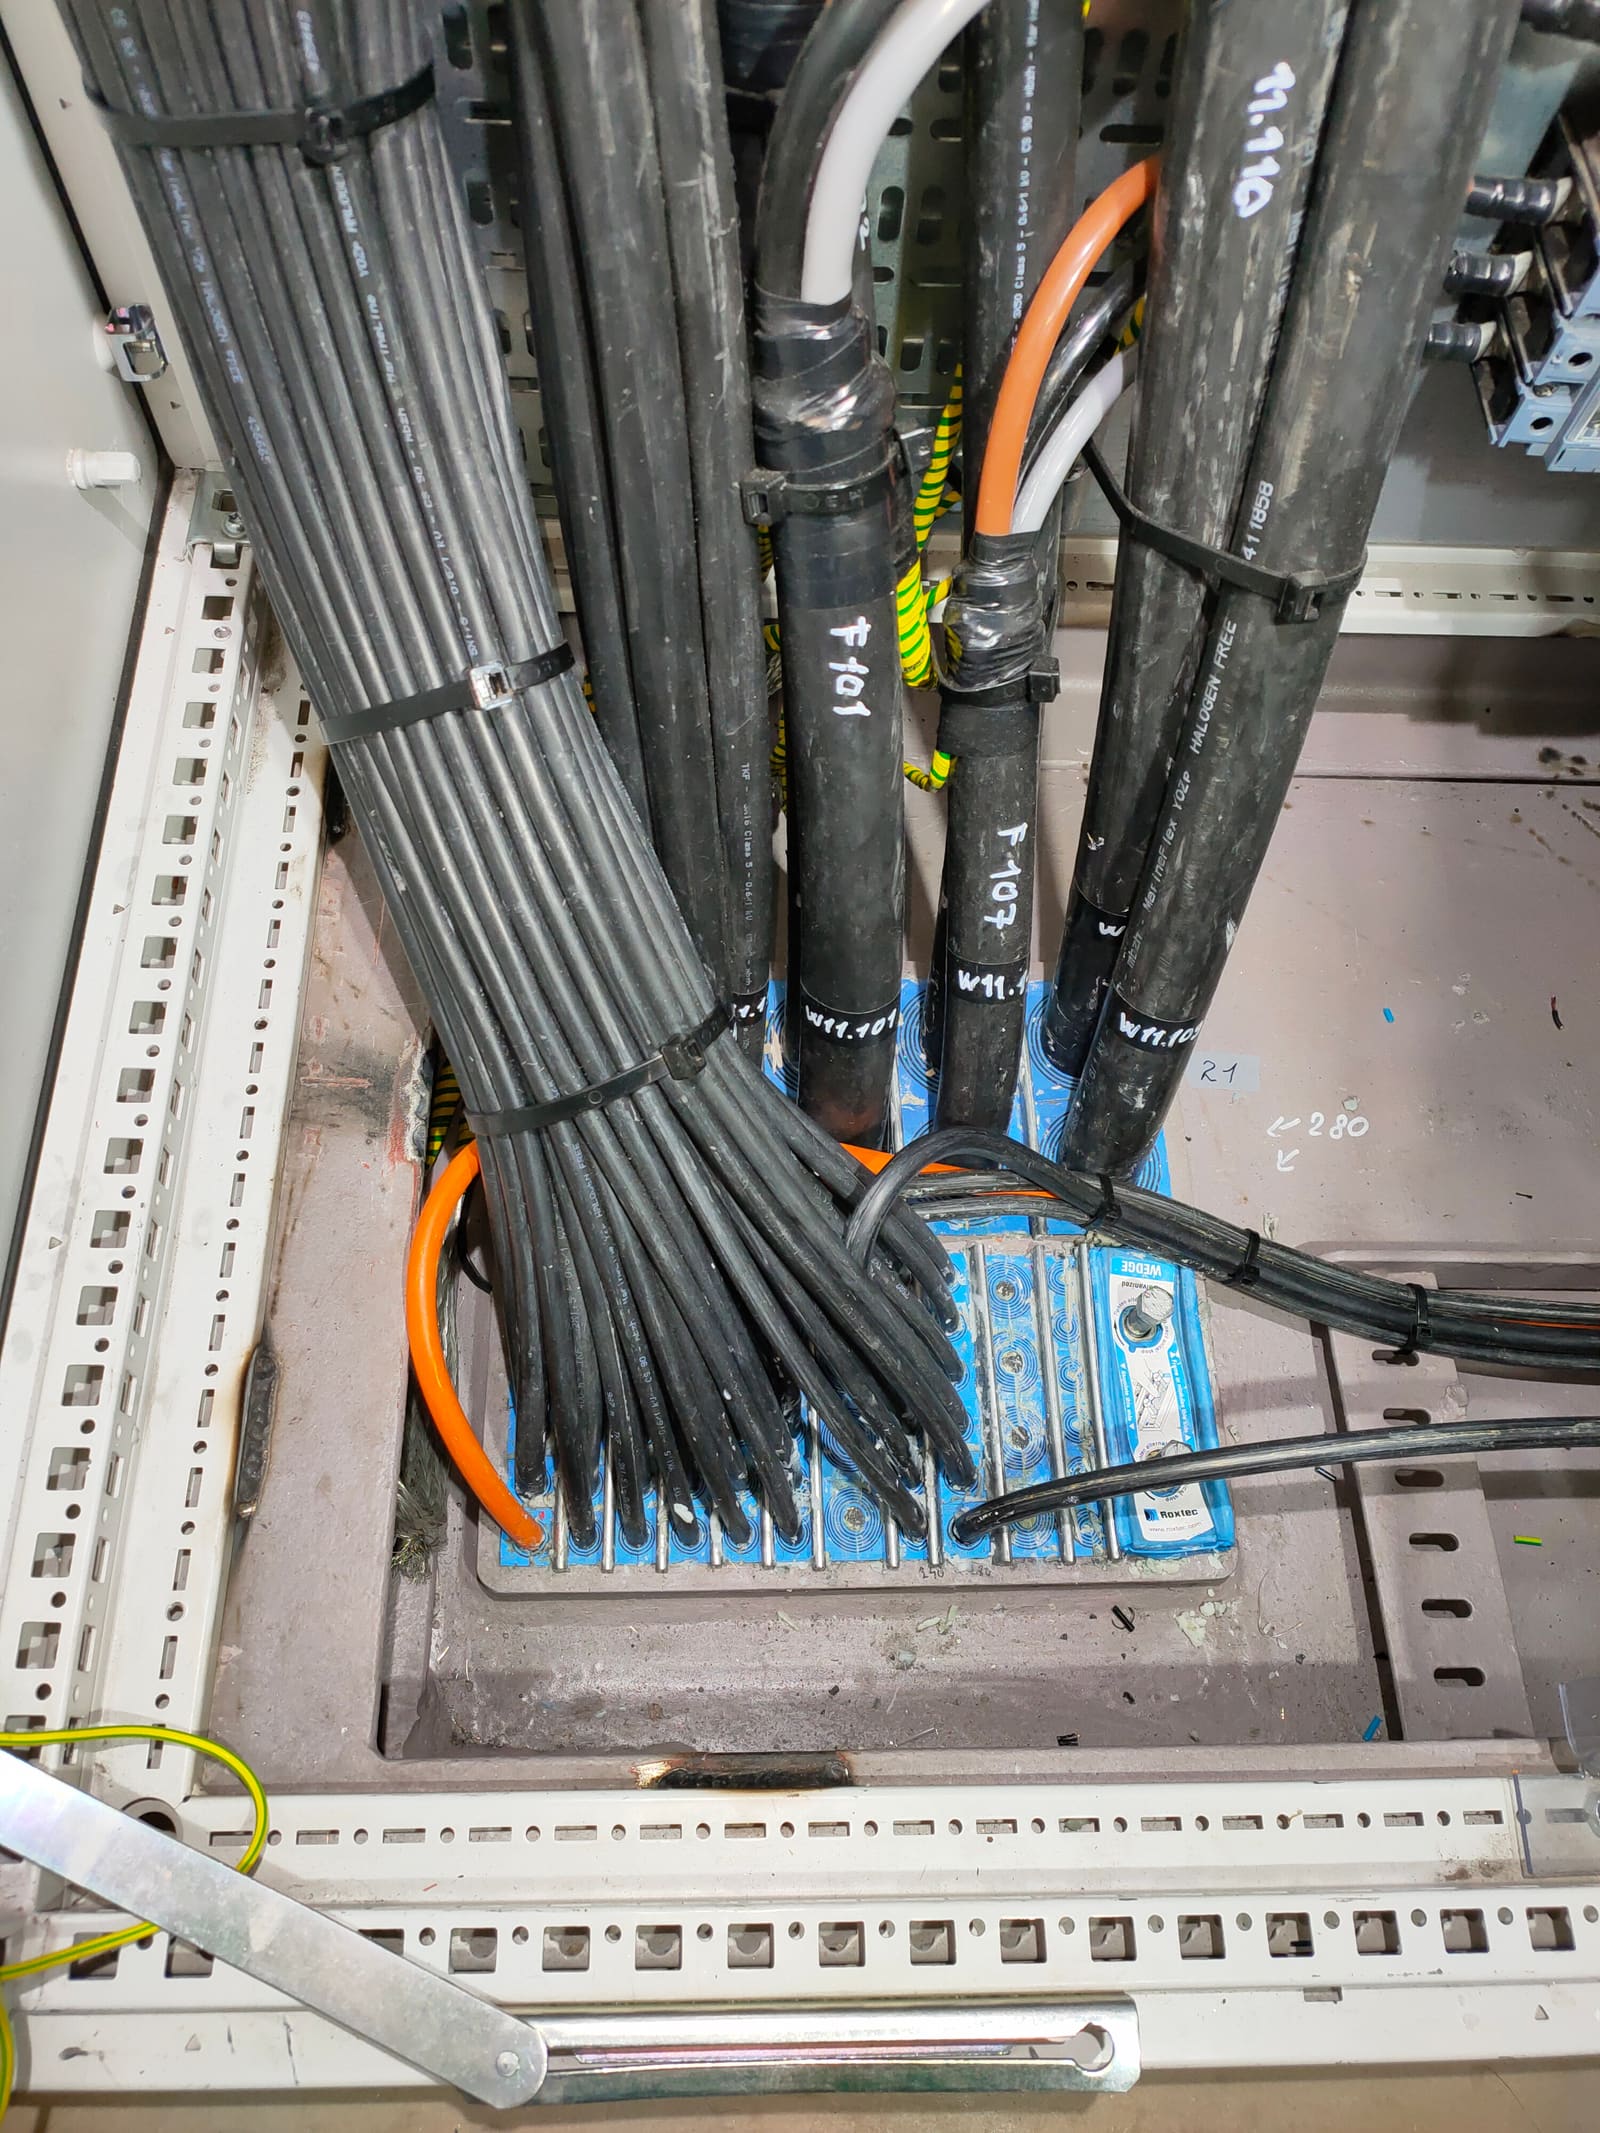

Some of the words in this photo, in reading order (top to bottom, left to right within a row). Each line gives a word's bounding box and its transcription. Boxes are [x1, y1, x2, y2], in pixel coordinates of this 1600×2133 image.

[1189, 674, 1223, 756] HALOGEN
[1212, 619, 1238, 671] FREE
[1308, 1111, 1370, 1140] 280
[1121, 1260, 1162, 1278] WEDGE
[1160, 1508, 1199, 1519] Roxtec
